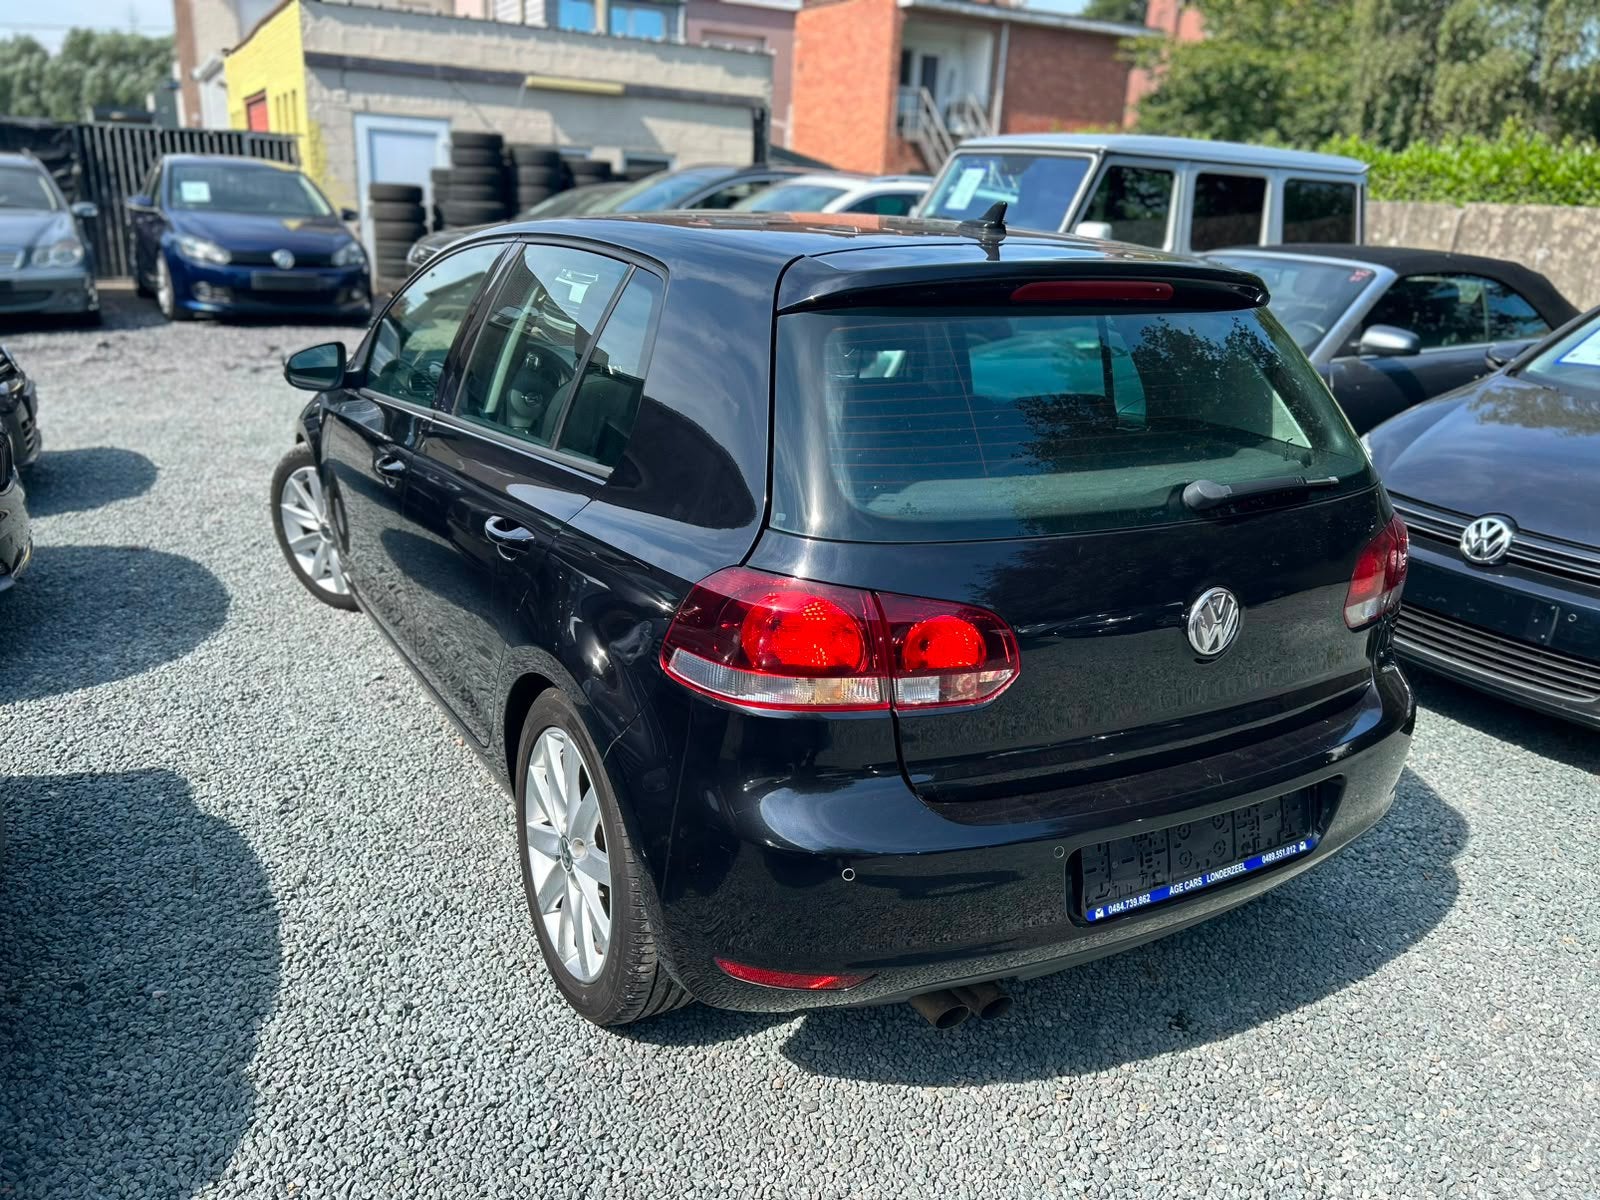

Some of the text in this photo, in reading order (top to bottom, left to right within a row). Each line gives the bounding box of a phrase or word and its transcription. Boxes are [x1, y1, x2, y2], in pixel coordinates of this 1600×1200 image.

[1169, 884, 1184, 895] AGE
[1184, 877, 1203, 892] CARS
[1206, 863, 1247, 883] LONDERZEEL
